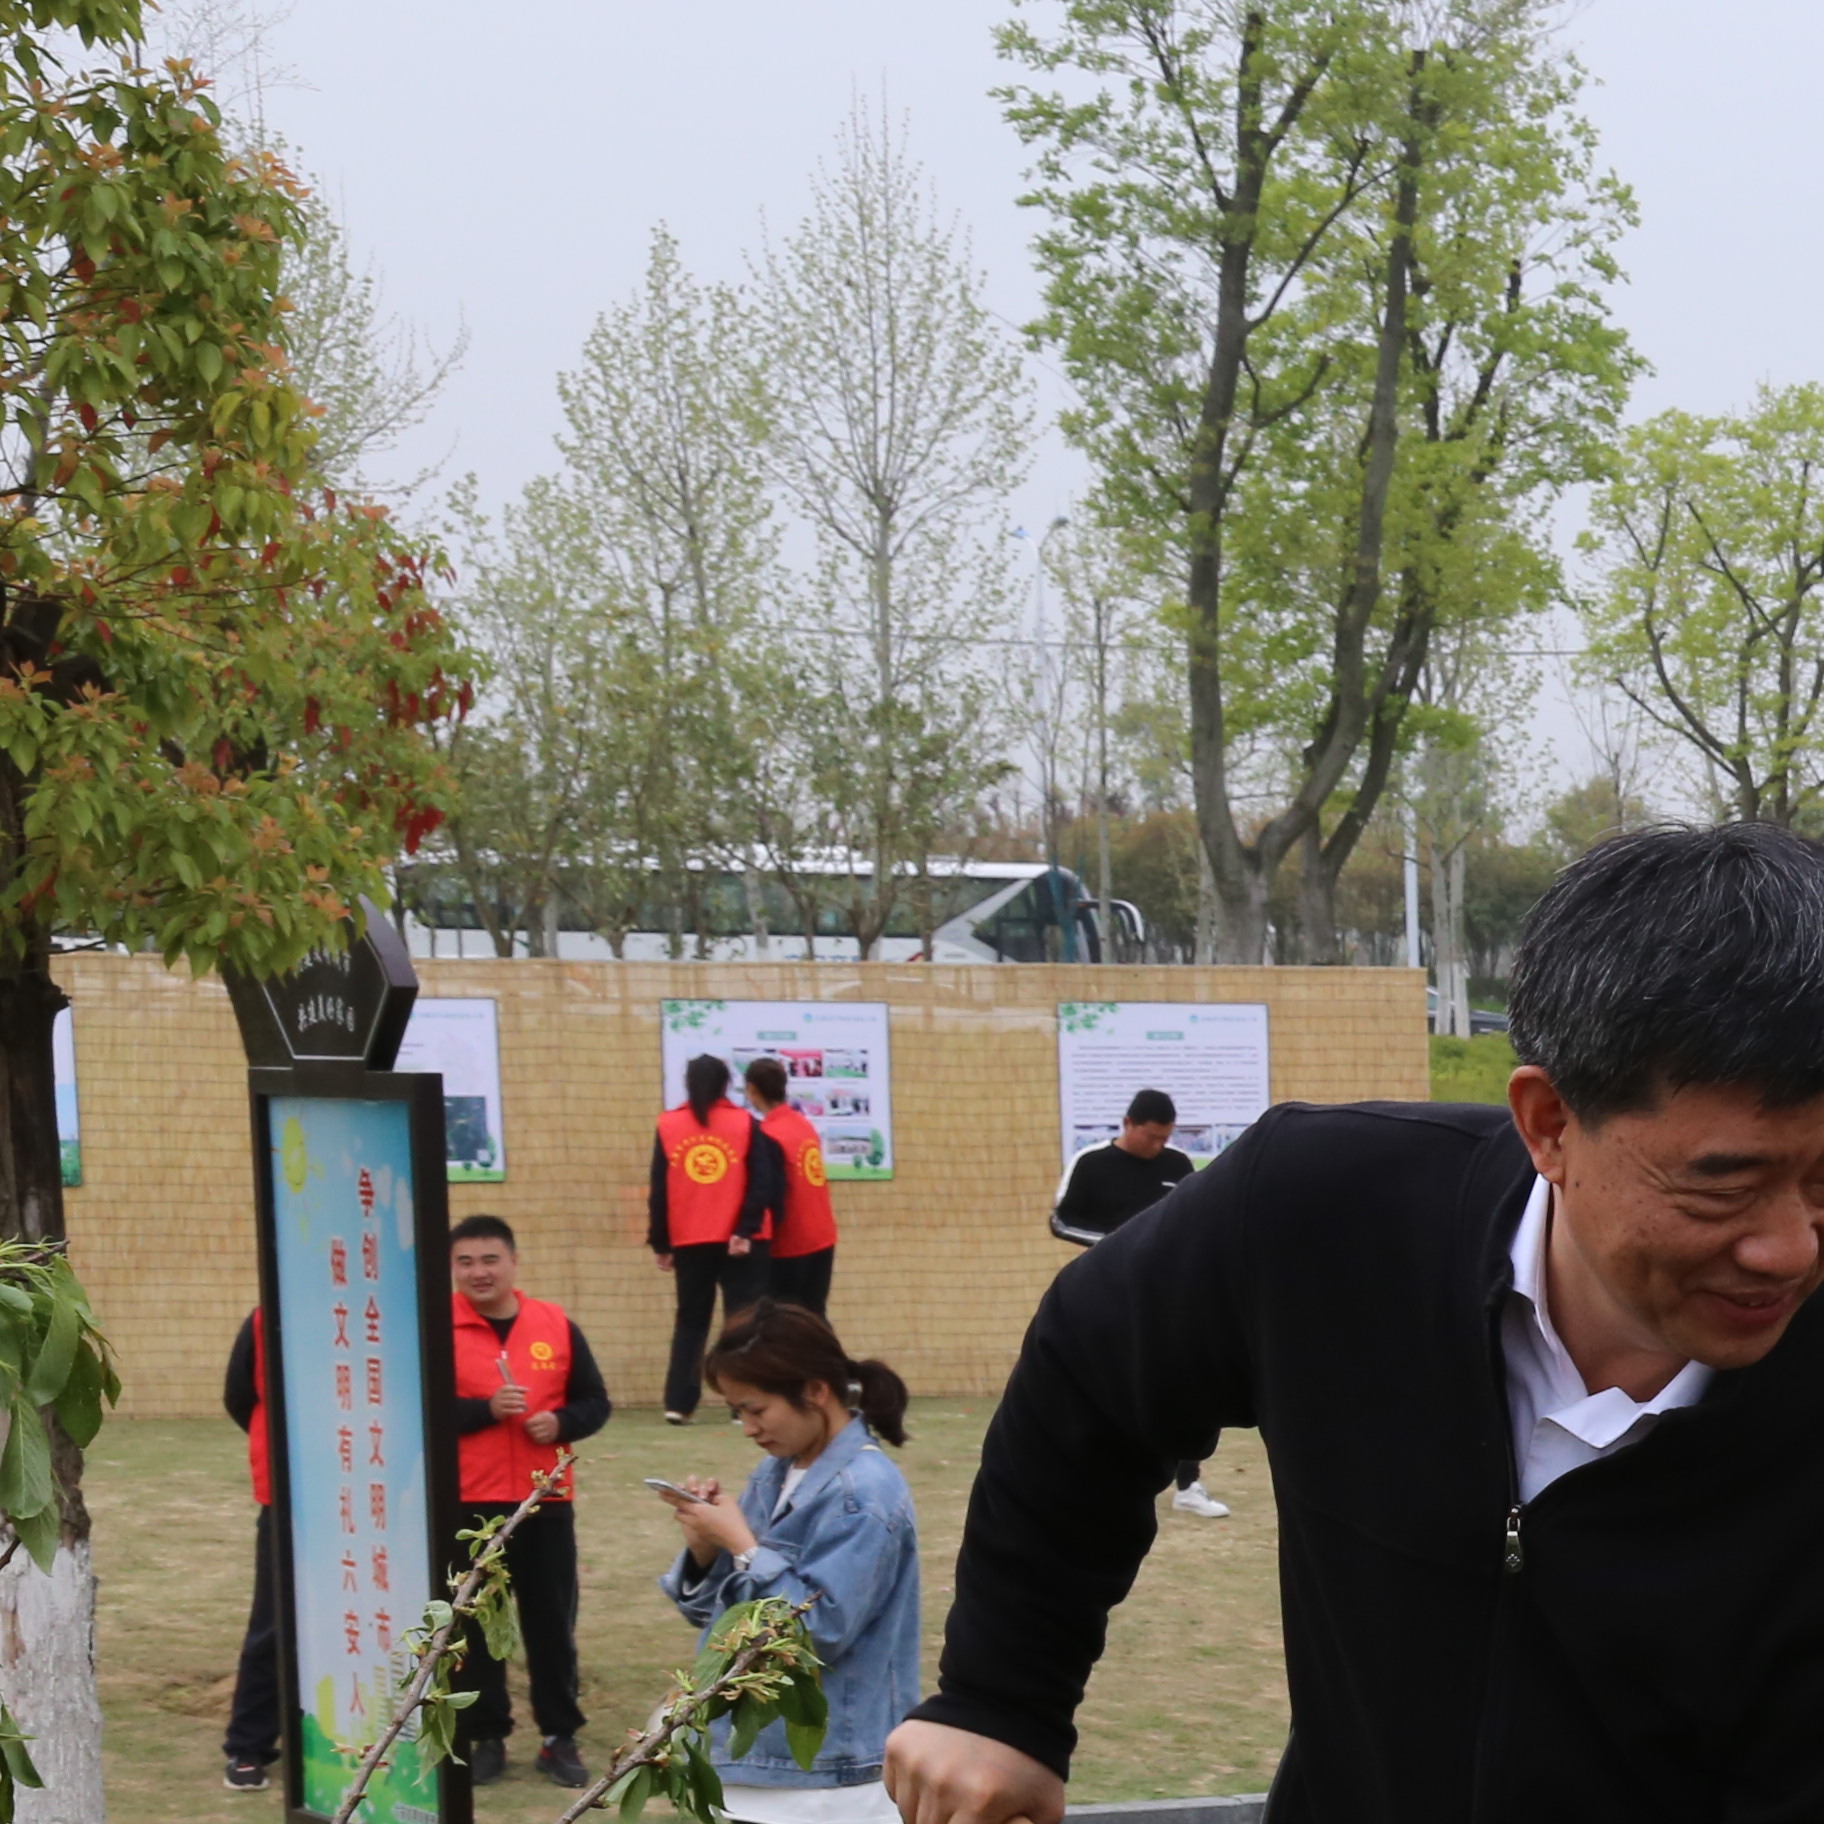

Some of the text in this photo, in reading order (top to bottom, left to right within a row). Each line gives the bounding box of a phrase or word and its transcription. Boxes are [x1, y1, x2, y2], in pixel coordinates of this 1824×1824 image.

[331, 1238, 366, 1715] 做文明有礼六安人
[358, 1168, 392, 1653] 争创全国文明城市
